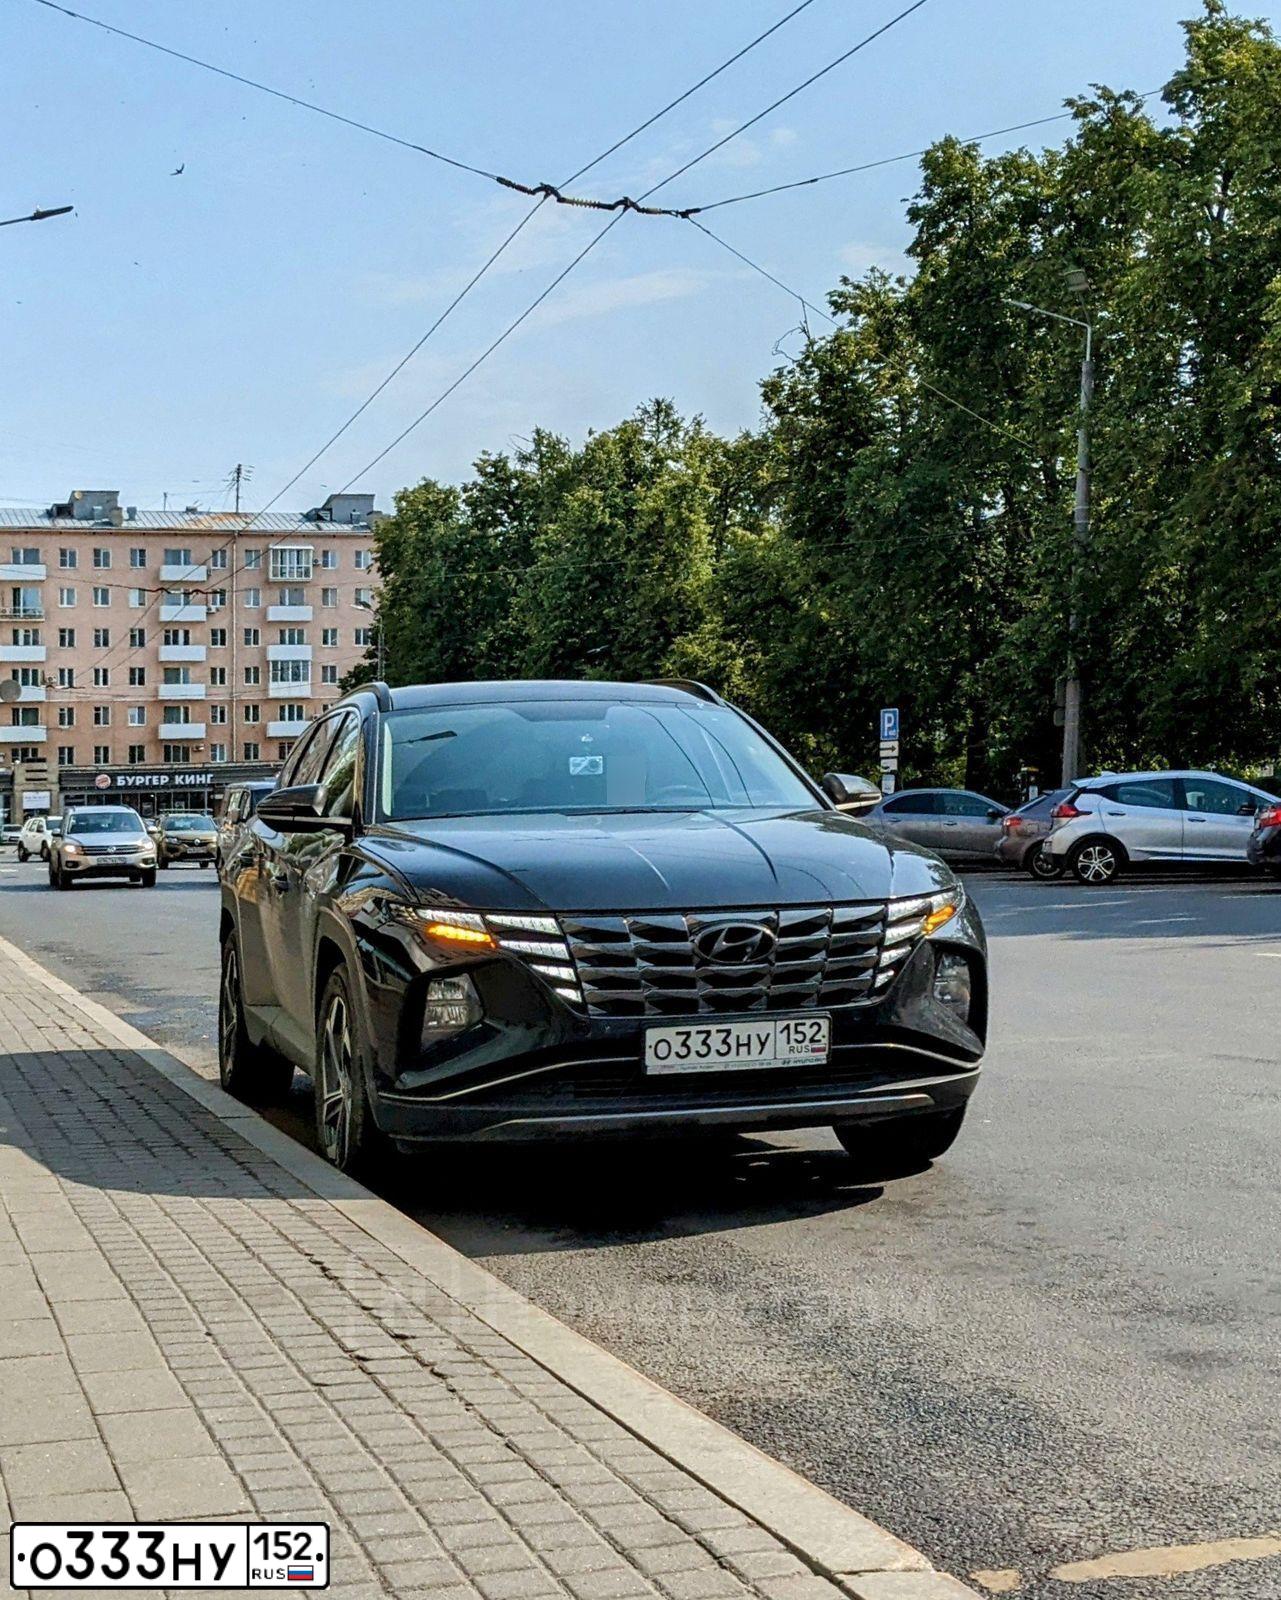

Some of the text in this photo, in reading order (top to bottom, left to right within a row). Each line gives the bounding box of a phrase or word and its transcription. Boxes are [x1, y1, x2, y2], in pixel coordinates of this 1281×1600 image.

[884, 713, 895, 737] P
[116, 774, 214, 786] БУРГЕР КИНГ
[654, 1022, 822, 1060] О333НУ 152
[788, 1044, 811, 1054] RUS
